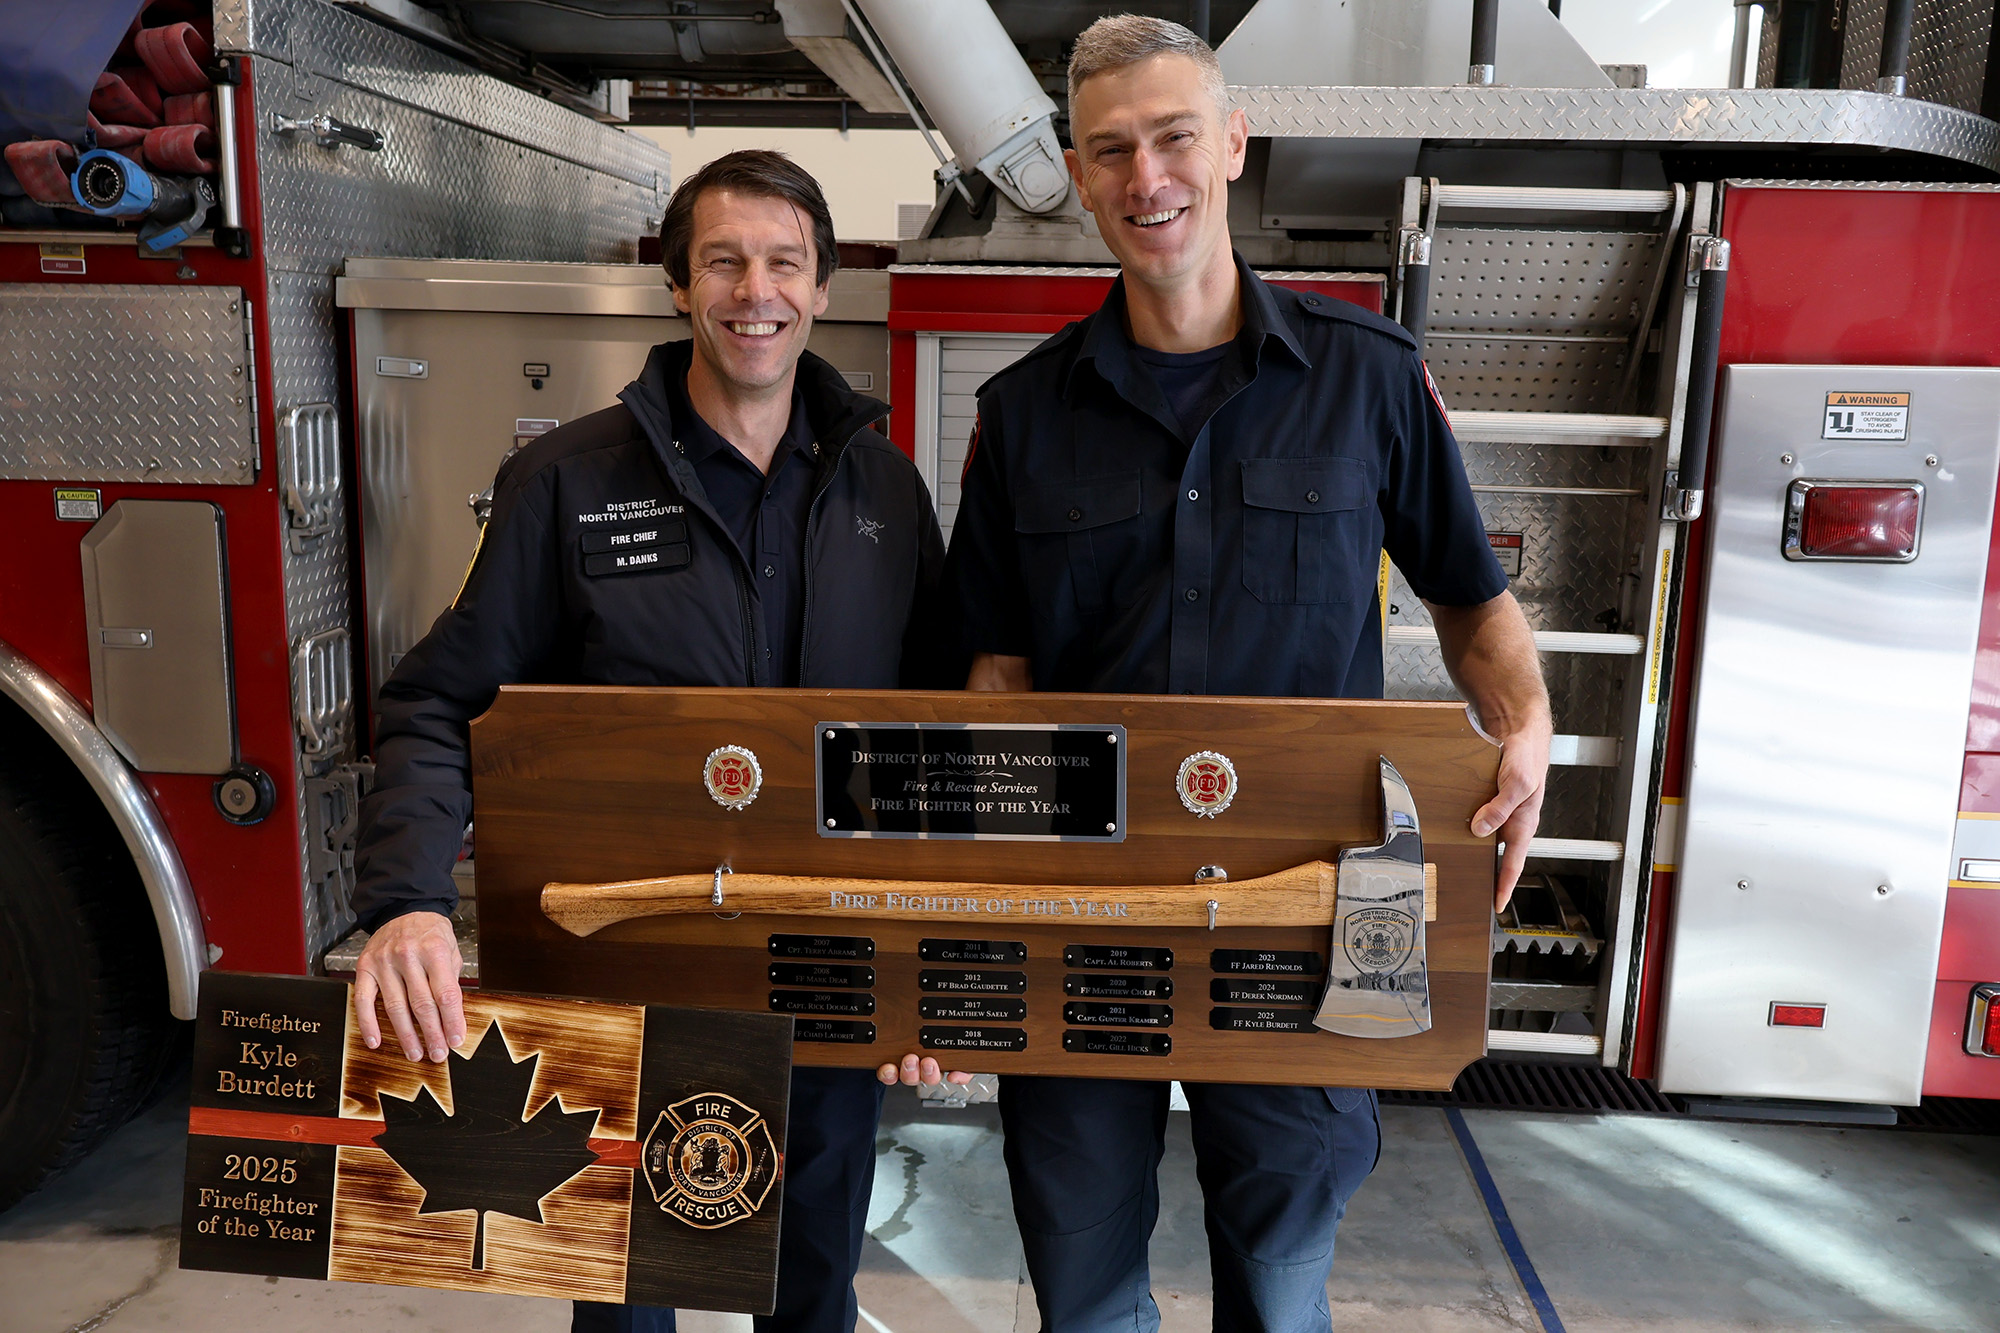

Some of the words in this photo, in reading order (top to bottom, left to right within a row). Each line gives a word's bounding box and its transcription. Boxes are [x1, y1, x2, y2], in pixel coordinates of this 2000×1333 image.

[1849, 396, 1898, 404] WARNING
[607, 499, 657, 512] DISTRICT
[578, 512, 618, 523] NORTH
[620, 505, 685, 520] VANCOUVER
[610, 534, 631, 545] FIRE
[632, 530, 658, 543] CHIEF
[1490, 537, 1508, 545] GER
[616, 557, 628, 567] M.
[629, 553, 659, 565] DANKS
[851, 750, 919, 764] DISTRICT
[921, 753, 941, 765] OF
[945, 752, 996, 766] NORTH
[1000, 752, 1090, 768] VANCOUVER
[724, 772, 740, 782] FD
[903, 780, 928, 792] Fire
[931, 781, 941, 792] &
[945, 781, 988, 793] Rescue
[989, 781, 1038, 794] Services
[1199, 778, 1215, 789] FD
[871, 798, 904, 811] FIRE
[908, 798, 972, 813] FIGHTER
[975, 801, 994, 813] OF
[998, 801, 1027, 813] THE
[1031, 800, 1071, 814] YEAR
[829, 890, 880, 910] FIRE
[885, 892, 980, 913] FIGHTER
[985, 897, 1014, 914] OF
[1020, 899, 1063, 915] THE
[1067, 897, 1129, 917] YEAR
[1350, 916, 1372, 926] NORTH
[1373, 915, 1410, 928] VANCOUVER
[965, 943, 981, 951] 2011
[942, 951, 962, 959] CAPT.
[980, 952, 1005, 960] SWANT
[1110, 949, 1128, 957] 2019
[1084, 957, 1107, 965] CAPT.
[1120, 959, 1153, 967] ROBERTS
[1241, 962, 1265, 970] JARED
[1265, 963, 1303, 971] REYNOLDS
[813, 967, 830, 975] 2008
[964, 973, 981, 981] 2012
[1092, 987, 1130, 995] MATTHEW
[1130, 988, 1156, 996] CIOLFI
[1241, 992, 1265, 1000] DEREK
[1266, 993, 1303, 1001] NORDMAN
[787, 1002, 807, 1010] CAPT.
[826, 1003, 859, 1012] DOUGLAS
[948, 1009, 985, 1017] MATTHEW
[220, 1009, 321, 1034] Firefighter
[1077, 1014, 1097, 1022] CAPT.
[1098, 1015, 1127, 1023] GUNTER
[1128, 1016, 1159, 1024] KRAMER
[1233, 1019, 1244, 1027] FF
[1245, 1020, 1265, 1028] KYLE
[1266, 1020, 1299, 1029] BURDETT
[964, 1030, 982, 1038] 2018
[1110, 1035, 1127, 1043] 2022
[934, 1038, 956, 1046] CAPT.
[957, 1038, 978, 1046] DOUG
[979, 1039, 1012, 1047] BECKETT
[1087, 1042, 1108, 1051] CAPT.
[1127, 1044, 1149, 1053] HICKS
[239, 1041, 298, 1070] Kyle
[216, 1070, 316, 1099] Burdett
[695, 1102, 732, 1119] FIRE
[687, 1124, 724, 1138] DISTRICT
[725, 1131, 737, 1141] OF
[223, 1154, 298, 1184] 2025
[675, 1168, 697, 1194] NORTH
[698, 1172, 743, 1198] VANCOUVER
[198, 1188, 319, 1216] Firefighter
[674, 1197, 739, 1220] RESCUE
[197, 1215, 220, 1234] of
[224, 1217, 260, 1238] the
[266, 1219, 316, 1242] Year
